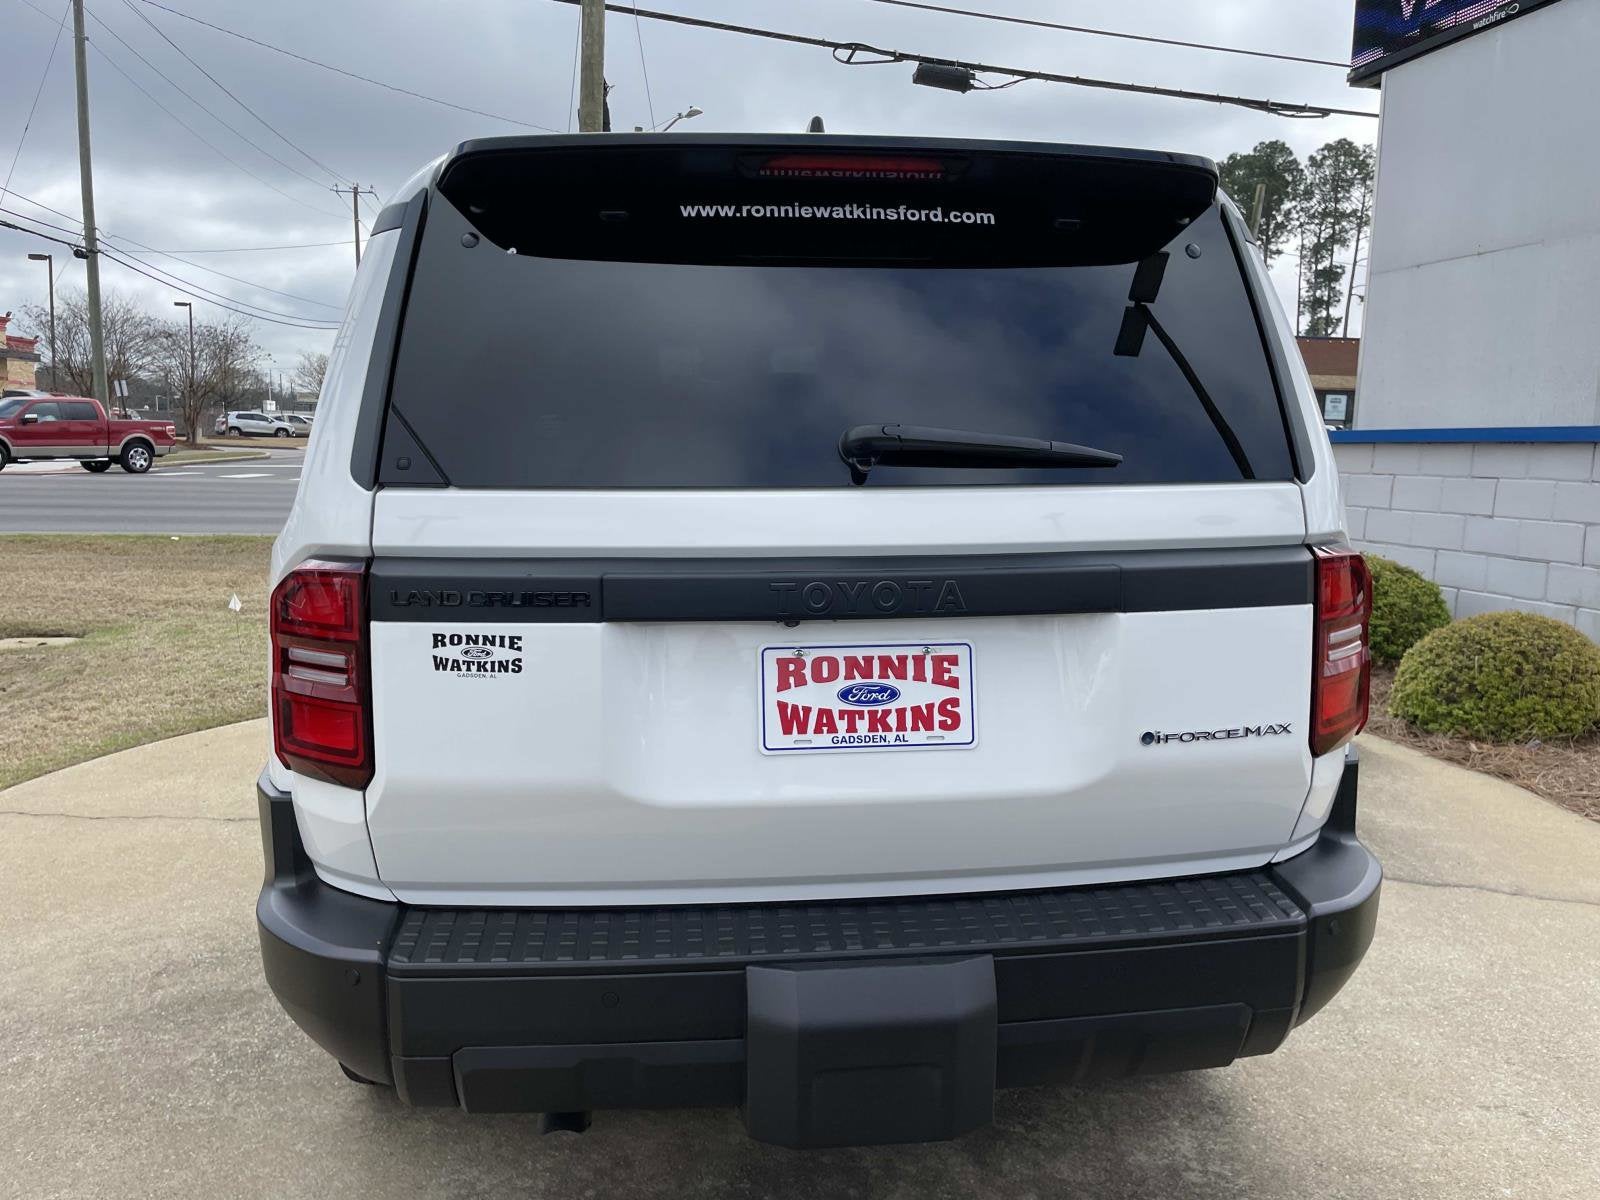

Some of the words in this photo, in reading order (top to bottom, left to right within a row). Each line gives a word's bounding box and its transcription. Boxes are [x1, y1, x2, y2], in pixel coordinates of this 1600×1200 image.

[1472, 11, 1506, 30] watchfire
[680, 203, 995, 225] www.ronniewatkinsford.com
[390, 590, 463, 607] LAND
[467, 591, 592, 608] CRUISER
[769, 580, 967, 615] TOYOTA
[432, 633, 523, 653] RONNIE
[432, 655, 523, 674] WATKINS
[776, 654, 960, 692] RONNIE
[847, 685, 892, 701] Ford
[777, 697, 961, 736] WATKINS
[831, 734, 891, 745] GADSDEN,
[893, 734, 909, 744] AL
